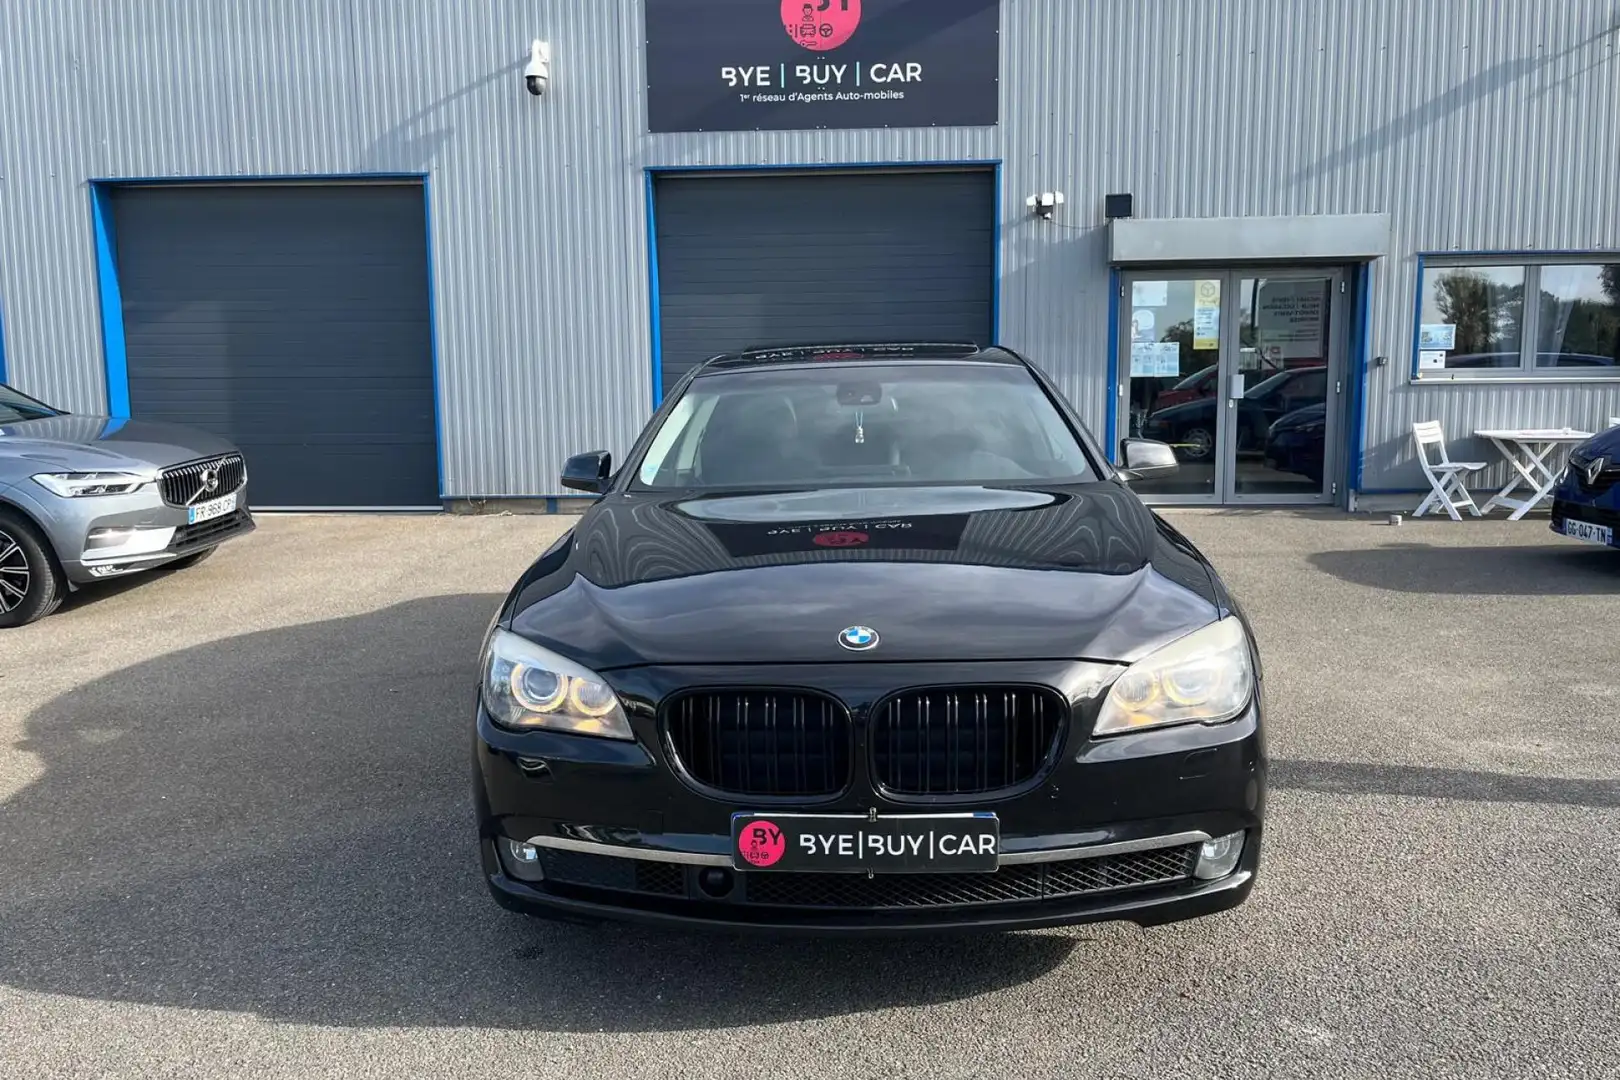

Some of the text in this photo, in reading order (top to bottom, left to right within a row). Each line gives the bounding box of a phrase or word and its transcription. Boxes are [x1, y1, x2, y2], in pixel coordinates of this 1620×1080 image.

[721, 66, 771, 87] BYE
[795, 64, 847, 84] BUY
[869, 62, 922, 83] CAR
[752, 92, 786, 102] réseau
[835, 90, 904, 100] Auto-mobiles
[753, 828, 781, 845] BY
[799, 834, 854, 855] BYE
[867, 834, 924, 856] BUY
[938, 834, 996, 855] CAR
